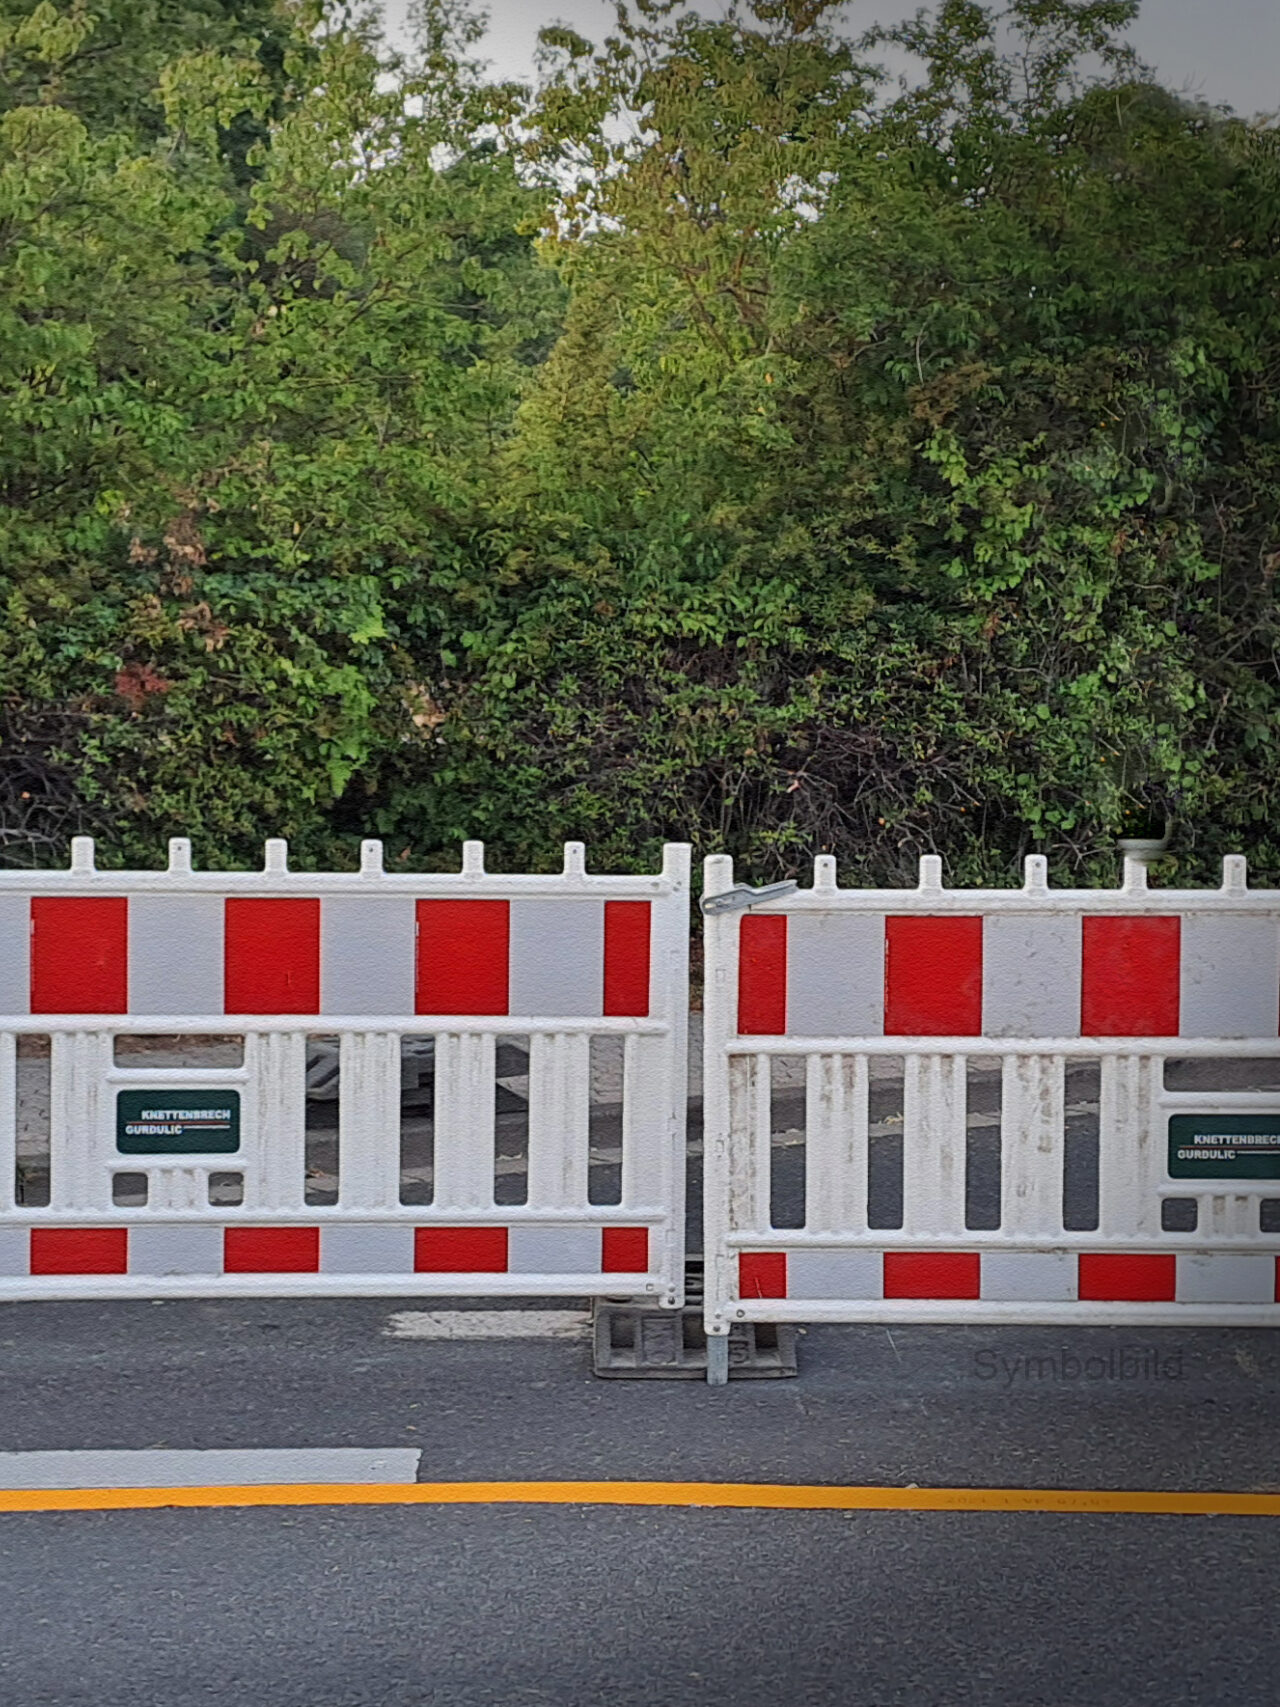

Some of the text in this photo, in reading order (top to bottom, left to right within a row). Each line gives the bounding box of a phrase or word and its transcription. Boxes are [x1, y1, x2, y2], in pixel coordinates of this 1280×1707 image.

[142, 1109, 230, 1120] KNETTENBRECH
[125, 1125, 182, 1135] GURDULIC
[1178, 1150, 1235, 1160] GURDULIC
